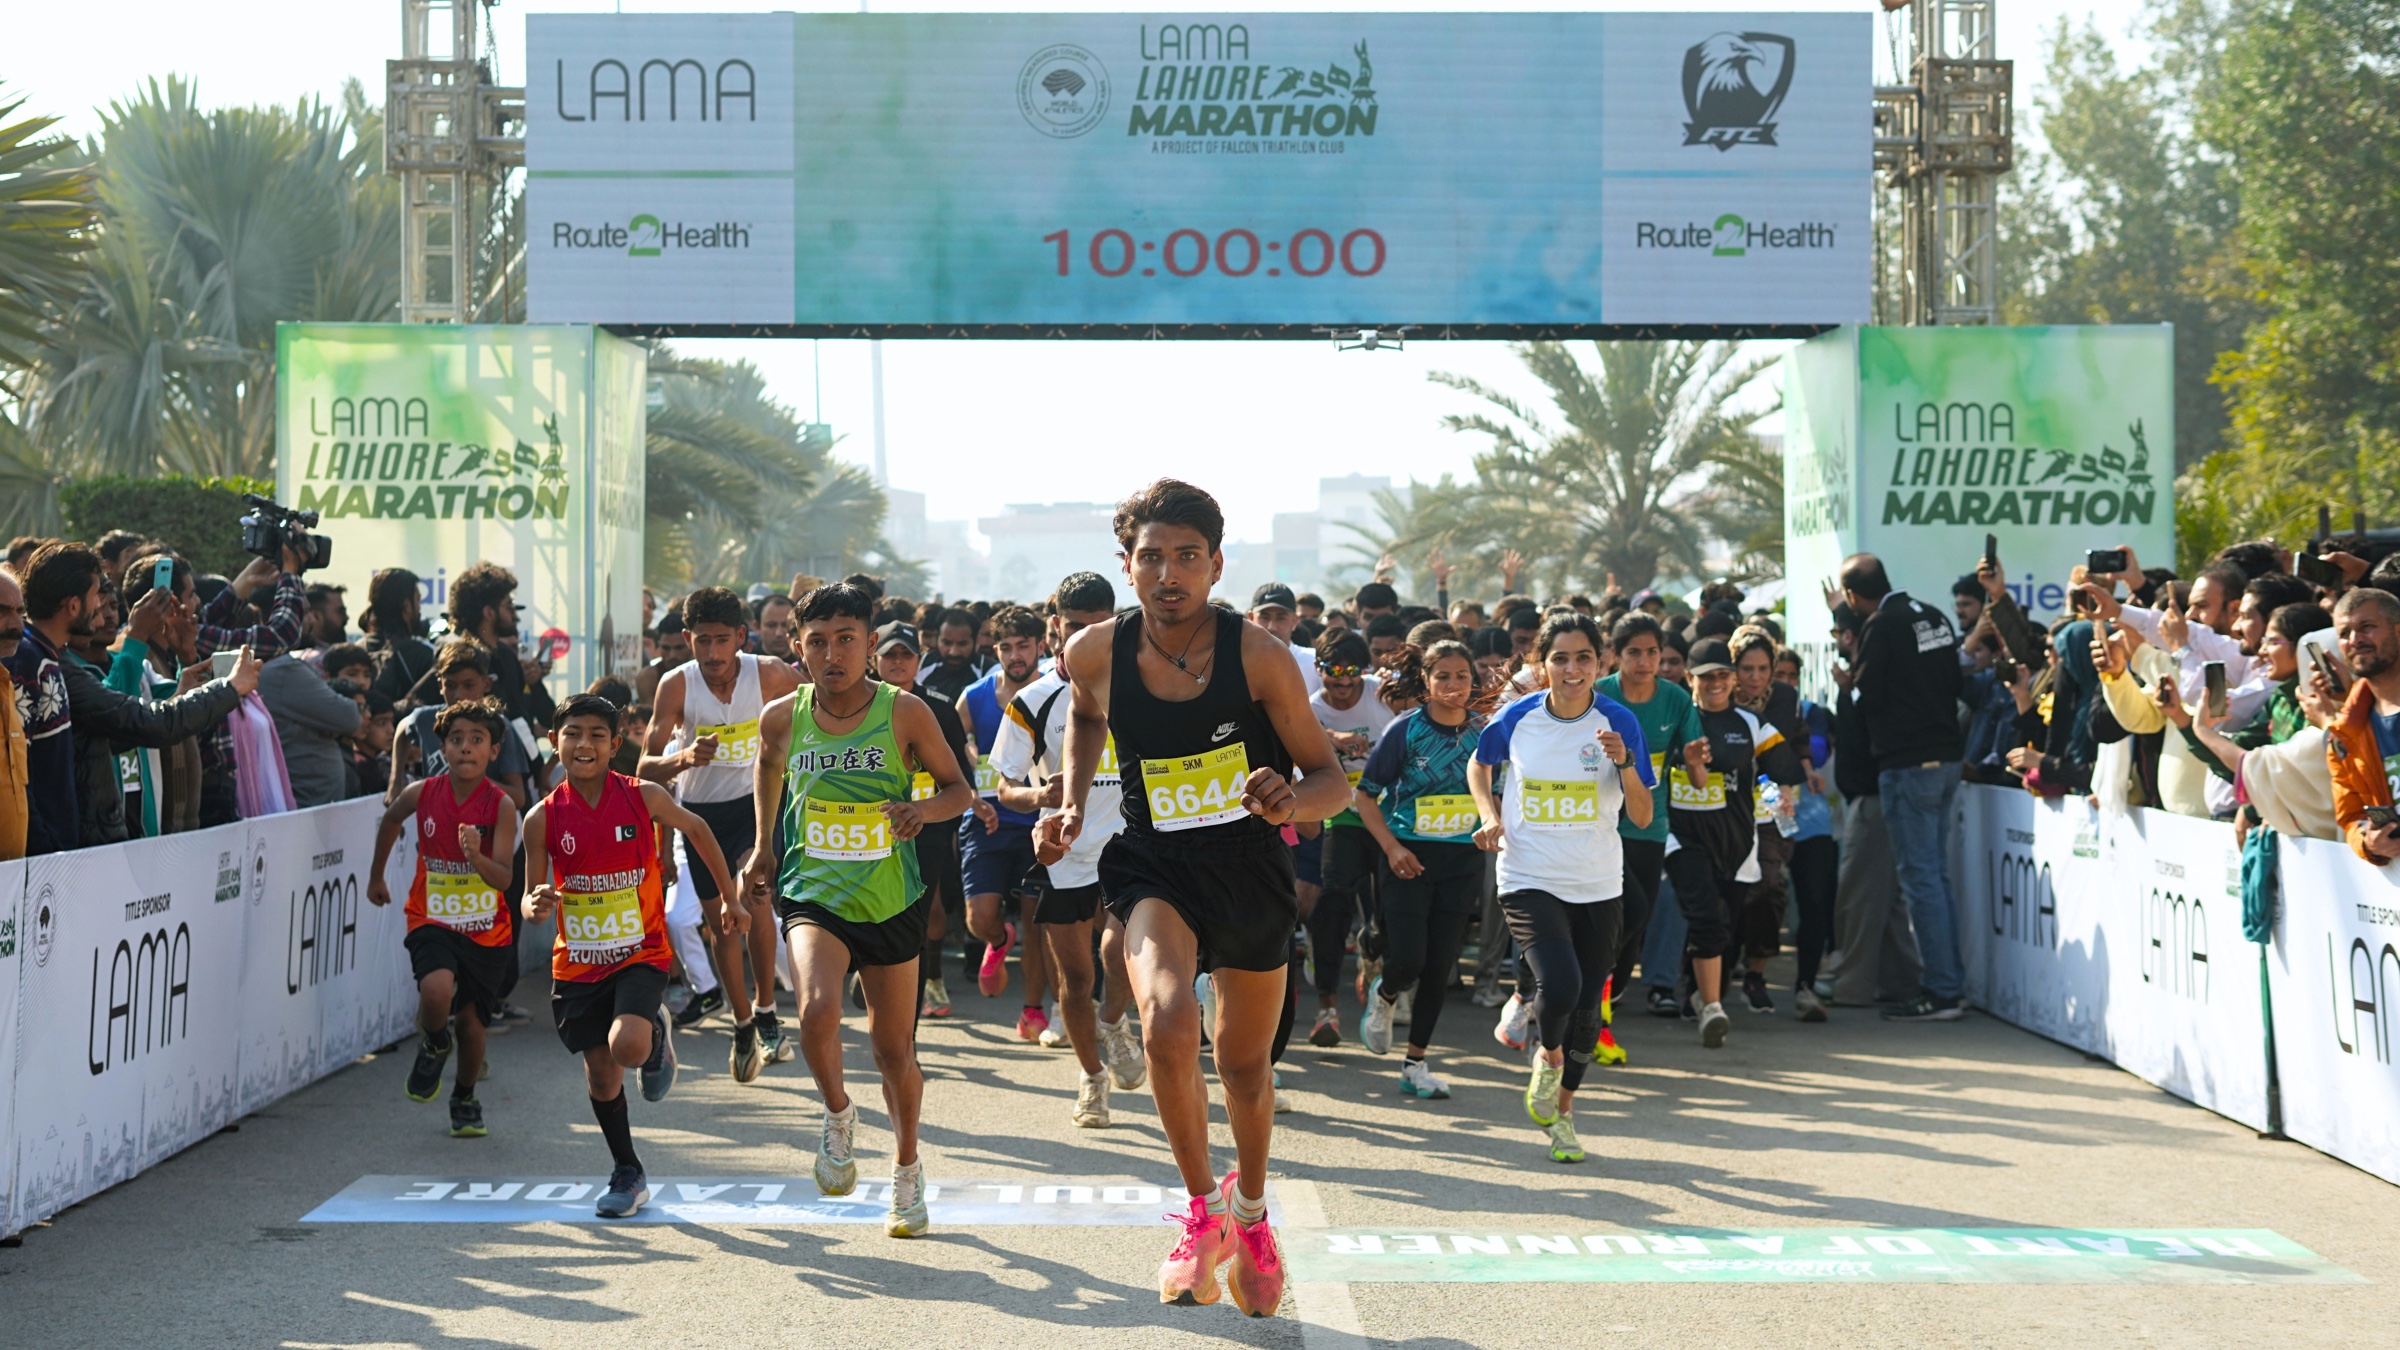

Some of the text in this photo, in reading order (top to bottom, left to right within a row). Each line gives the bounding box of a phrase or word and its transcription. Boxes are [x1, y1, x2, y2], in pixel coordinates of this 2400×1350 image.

[1140, 24, 1249, 61] LAMA
[557, 58, 756, 122] LAMA
[1135, 65, 1271, 101] LAHORE
[1127, 104, 1379, 137] MARATHON
[1700, 127, 1763, 142] FTC
[1152, 141, 1345, 154] A PROJECT OF FALCON TRIATHLON CLUB
[1042, 228, 1387, 278] 10:00:00
[311, 397, 429, 437] LAMA
[1895, 402, 2014, 442] LAMA
[305, 442, 452, 481] LAHORE
[1890, 448, 2037, 486] LAHORE
[296, 485, 569, 519] MARATHON
[1882, 490, 2157, 526] MARATHON
[715, 736, 758, 760] 655
[797, 745, 888, 773] 川口在家
[1182, 748, 1242, 771] 5KM LAMA
[1151, 770, 1246, 817] 6644
[1552, 783, 1566, 791] 5KM
[838, 805, 855, 814] 5KM
[1417, 812, 1477, 831] 6449
[1524, 796, 1595, 819] 5184
[807, 821, 885, 849] 6651
[125, 893, 171, 922] TITLE SPONSOR
[427, 890, 497, 915] 6630
[588, 896, 604, 906] 5KM
[1988, 848, 2057, 951] LAMA
[2356, 904, 2377, 923] TITLE
[287, 872, 358, 996] LAMA
[565, 908, 641, 940] 6645
[2139, 882, 2209, 1006] LAMA
[89, 921, 191, 1077] LAMA
[393, 1181, 788, 1203] LAORE
[1325, 1234, 2275, 1257] HEART OF A RUNNER
